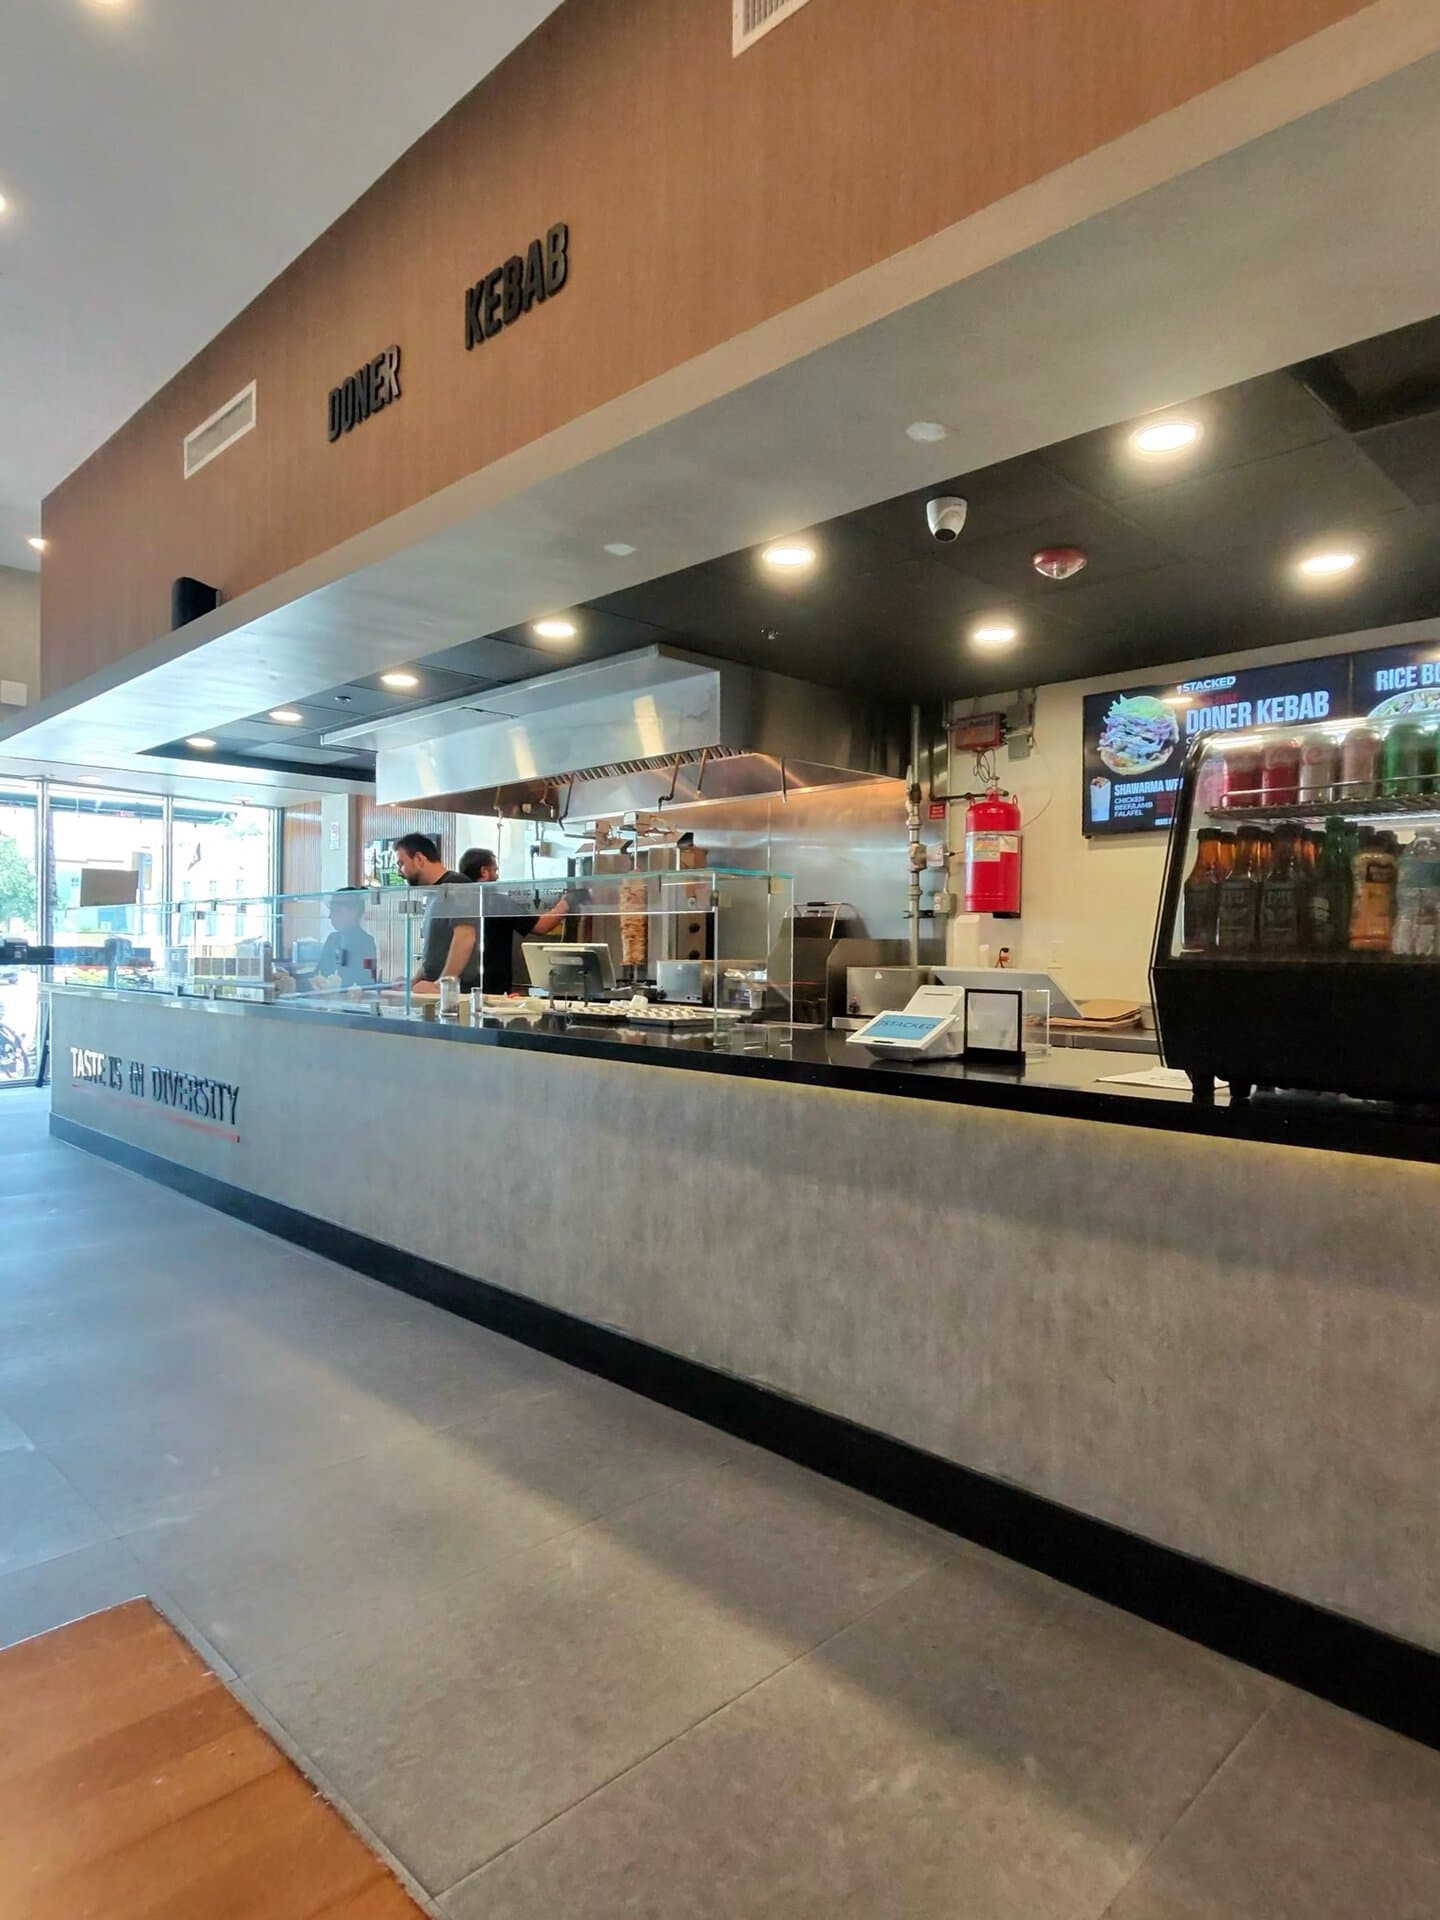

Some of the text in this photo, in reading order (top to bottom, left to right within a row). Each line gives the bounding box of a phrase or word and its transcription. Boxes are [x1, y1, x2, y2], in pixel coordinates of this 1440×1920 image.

[328, 222, 568, 443] DONER KEBAB
[1183, 675, 1237, 692] STACKED
[1376, 666, 1418, 692] RICE
[1186, 702, 1252, 735] DONER
[1256, 690, 1330, 724] KEBAB
[1114, 779, 1165, 796] SHAWARMA
[1114, 796, 1145, 804] CHICKEN
[1114, 809, 1144, 817] FALAFEL
[70, 1047, 107, 1087] TASTE
[108, 1055, 123, 1091] IS
[151, 1065, 241, 1126] DIVERSITY
